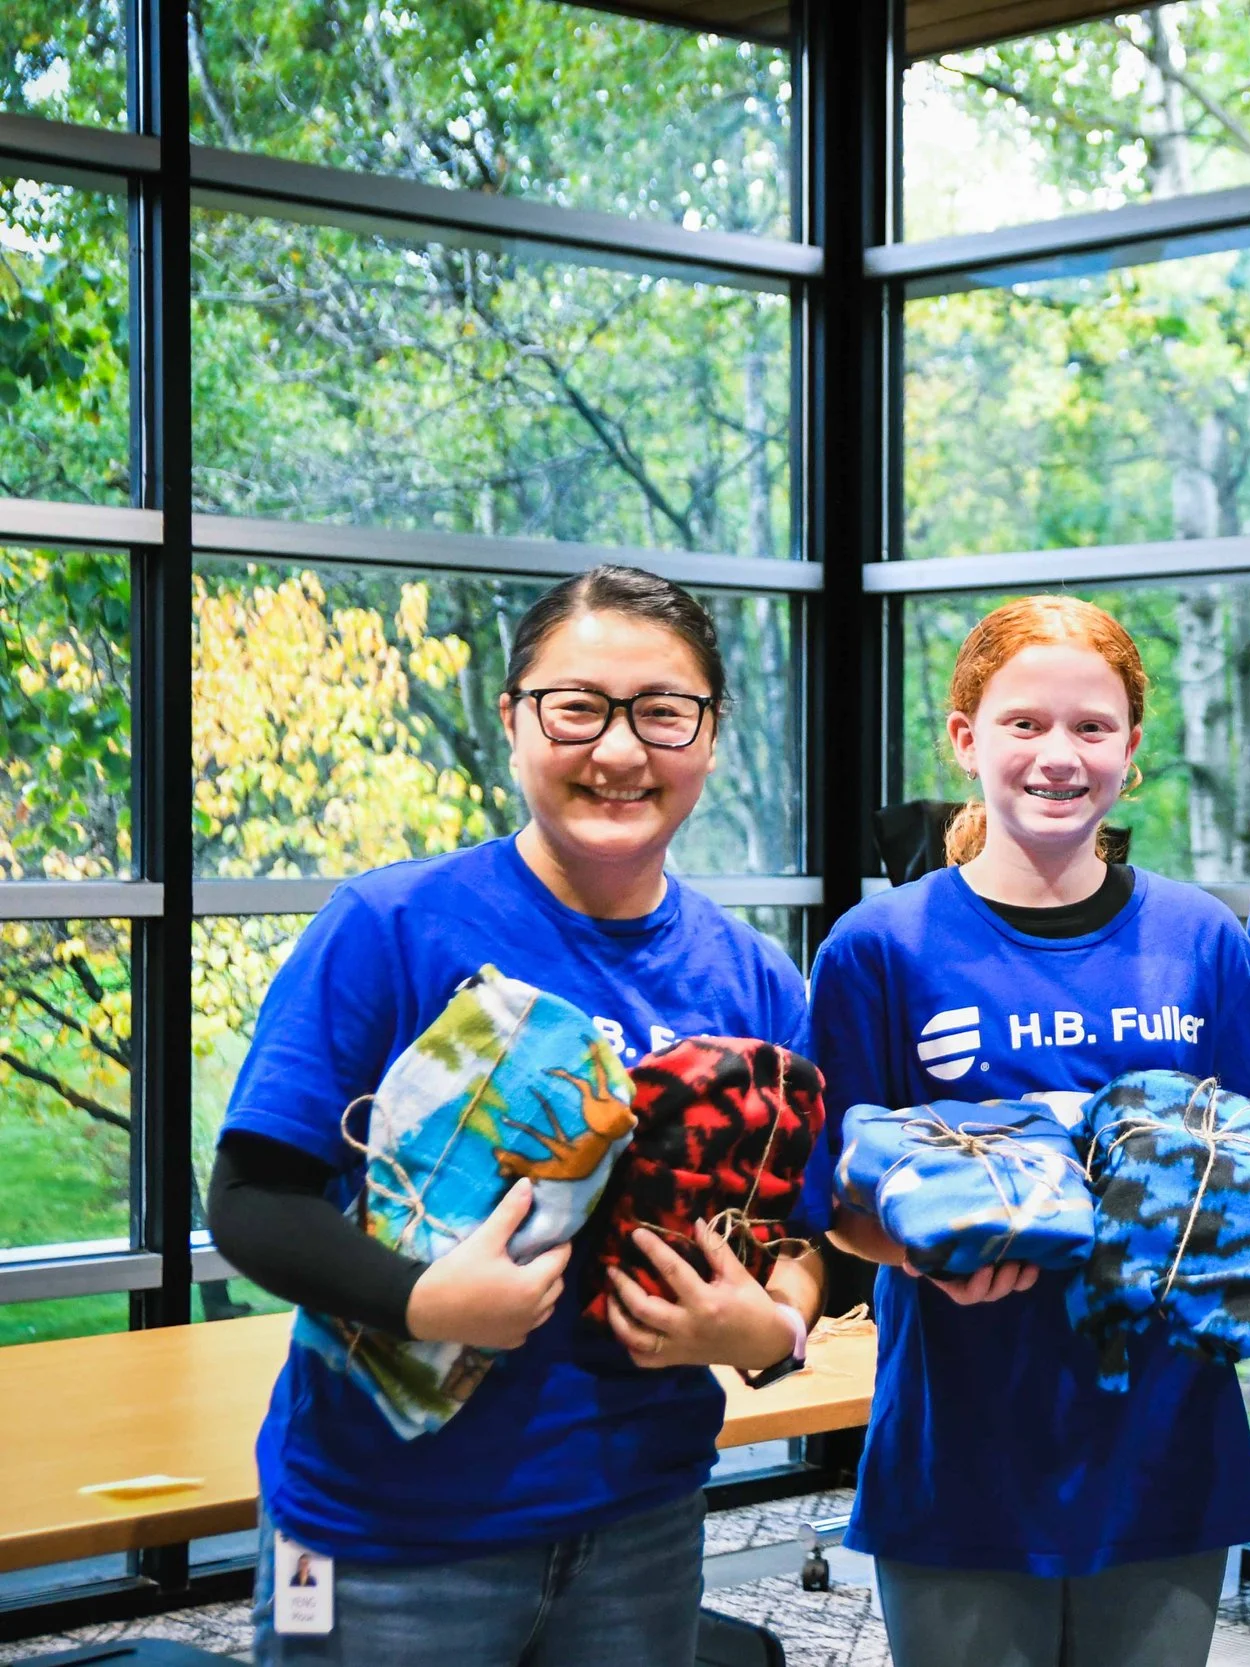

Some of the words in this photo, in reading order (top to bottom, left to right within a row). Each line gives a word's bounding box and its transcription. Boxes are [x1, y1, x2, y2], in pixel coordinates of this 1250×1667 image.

[592, 1016, 637, 1058] B.
[1009, 1011, 1097, 1049] H.B.
[1111, 1006, 1204, 1044] Fuller
